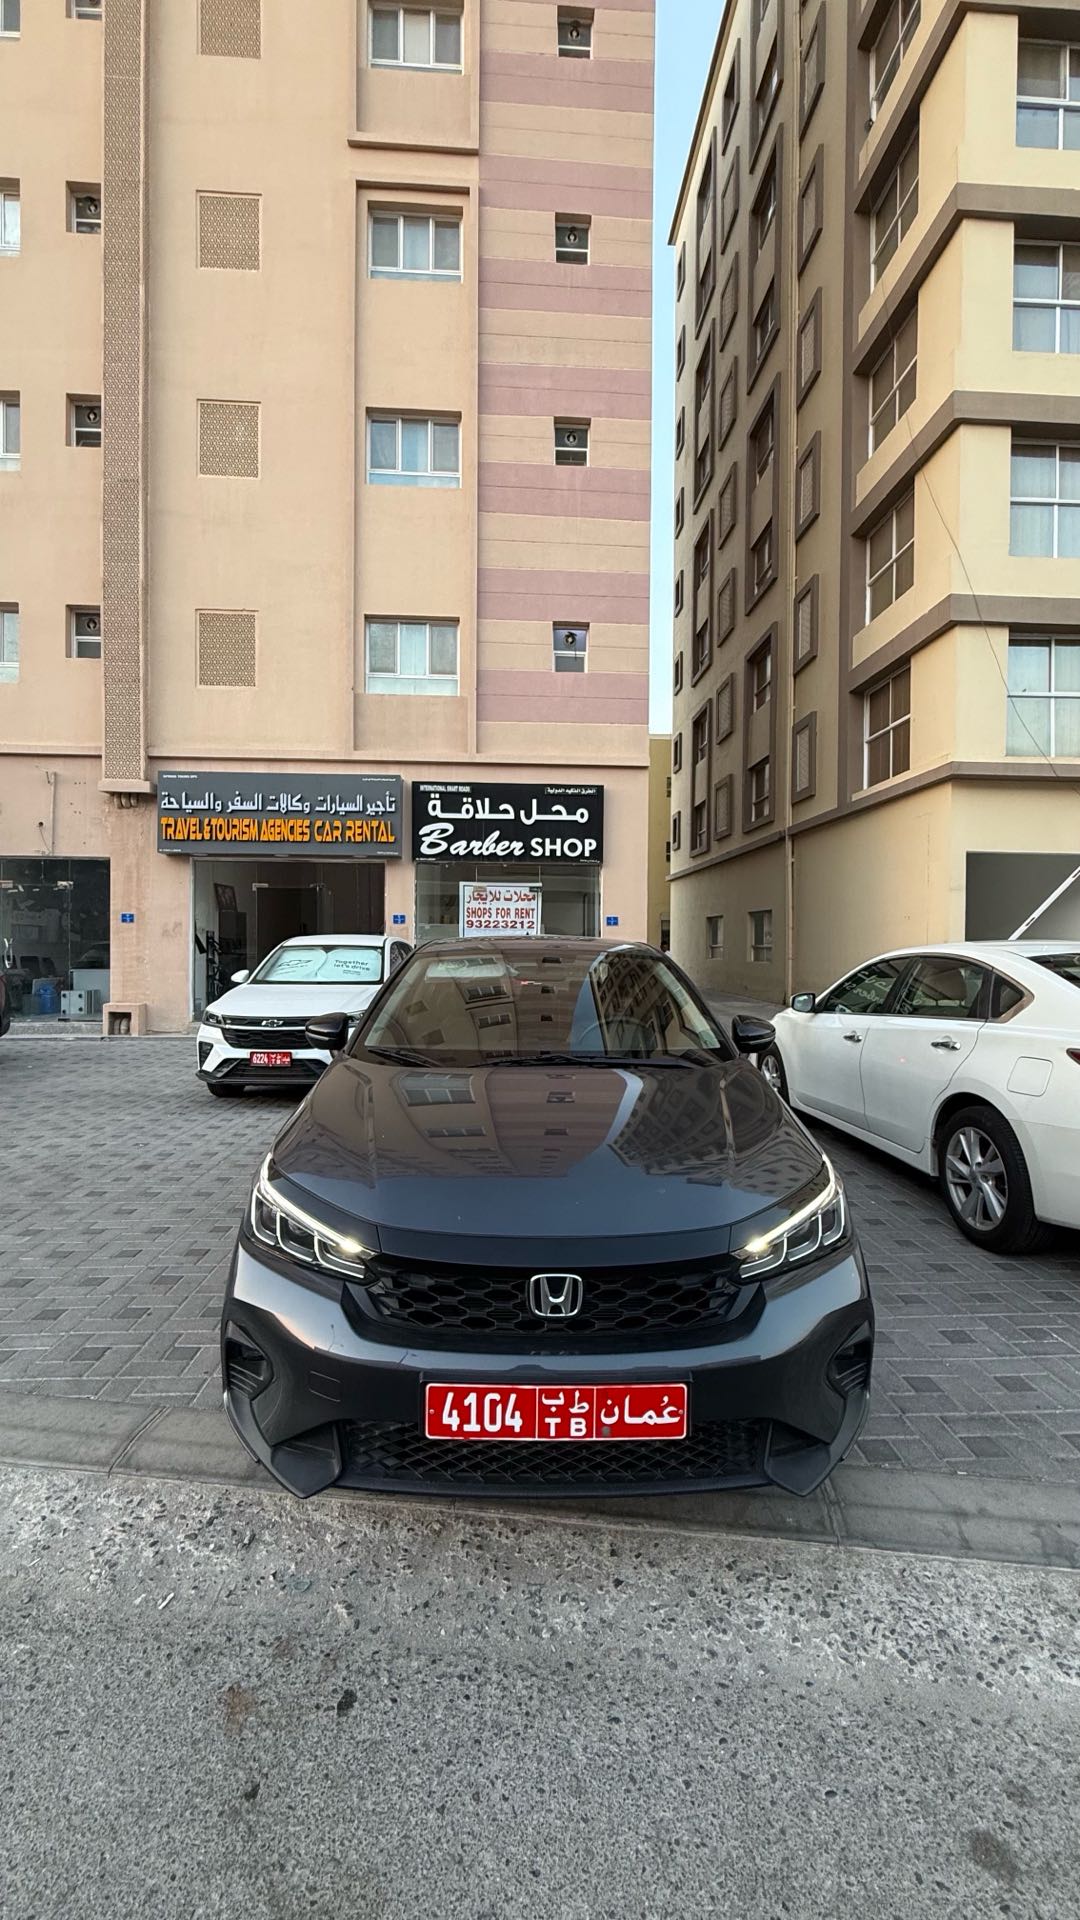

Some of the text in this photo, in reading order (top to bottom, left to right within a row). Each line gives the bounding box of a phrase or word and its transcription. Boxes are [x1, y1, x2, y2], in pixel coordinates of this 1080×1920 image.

[160, 790, 396, 816] تأجير السيارات وكالات السفر والسياحة
[427, 793, 589, 825] محل حلاقة
[160, 817, 203, 840] TRAVEL
[260, 818, 310, 842] AGENCIES
[314, 820, 342, 842] CAR
[345, 820, 396, 843] RENTAL
[418, 822, 597, 857] Barber SHOP
[503, 889, 536, 903] محلات
[466, 907, 535, 919] SHOPS FOR RENT
[466, 919, 535, 929] 93223212
[335, 959, 369, 967] Together
[252, 1053, 268, 1064] 6224
[442, 1391, 524, 1433] 4104
